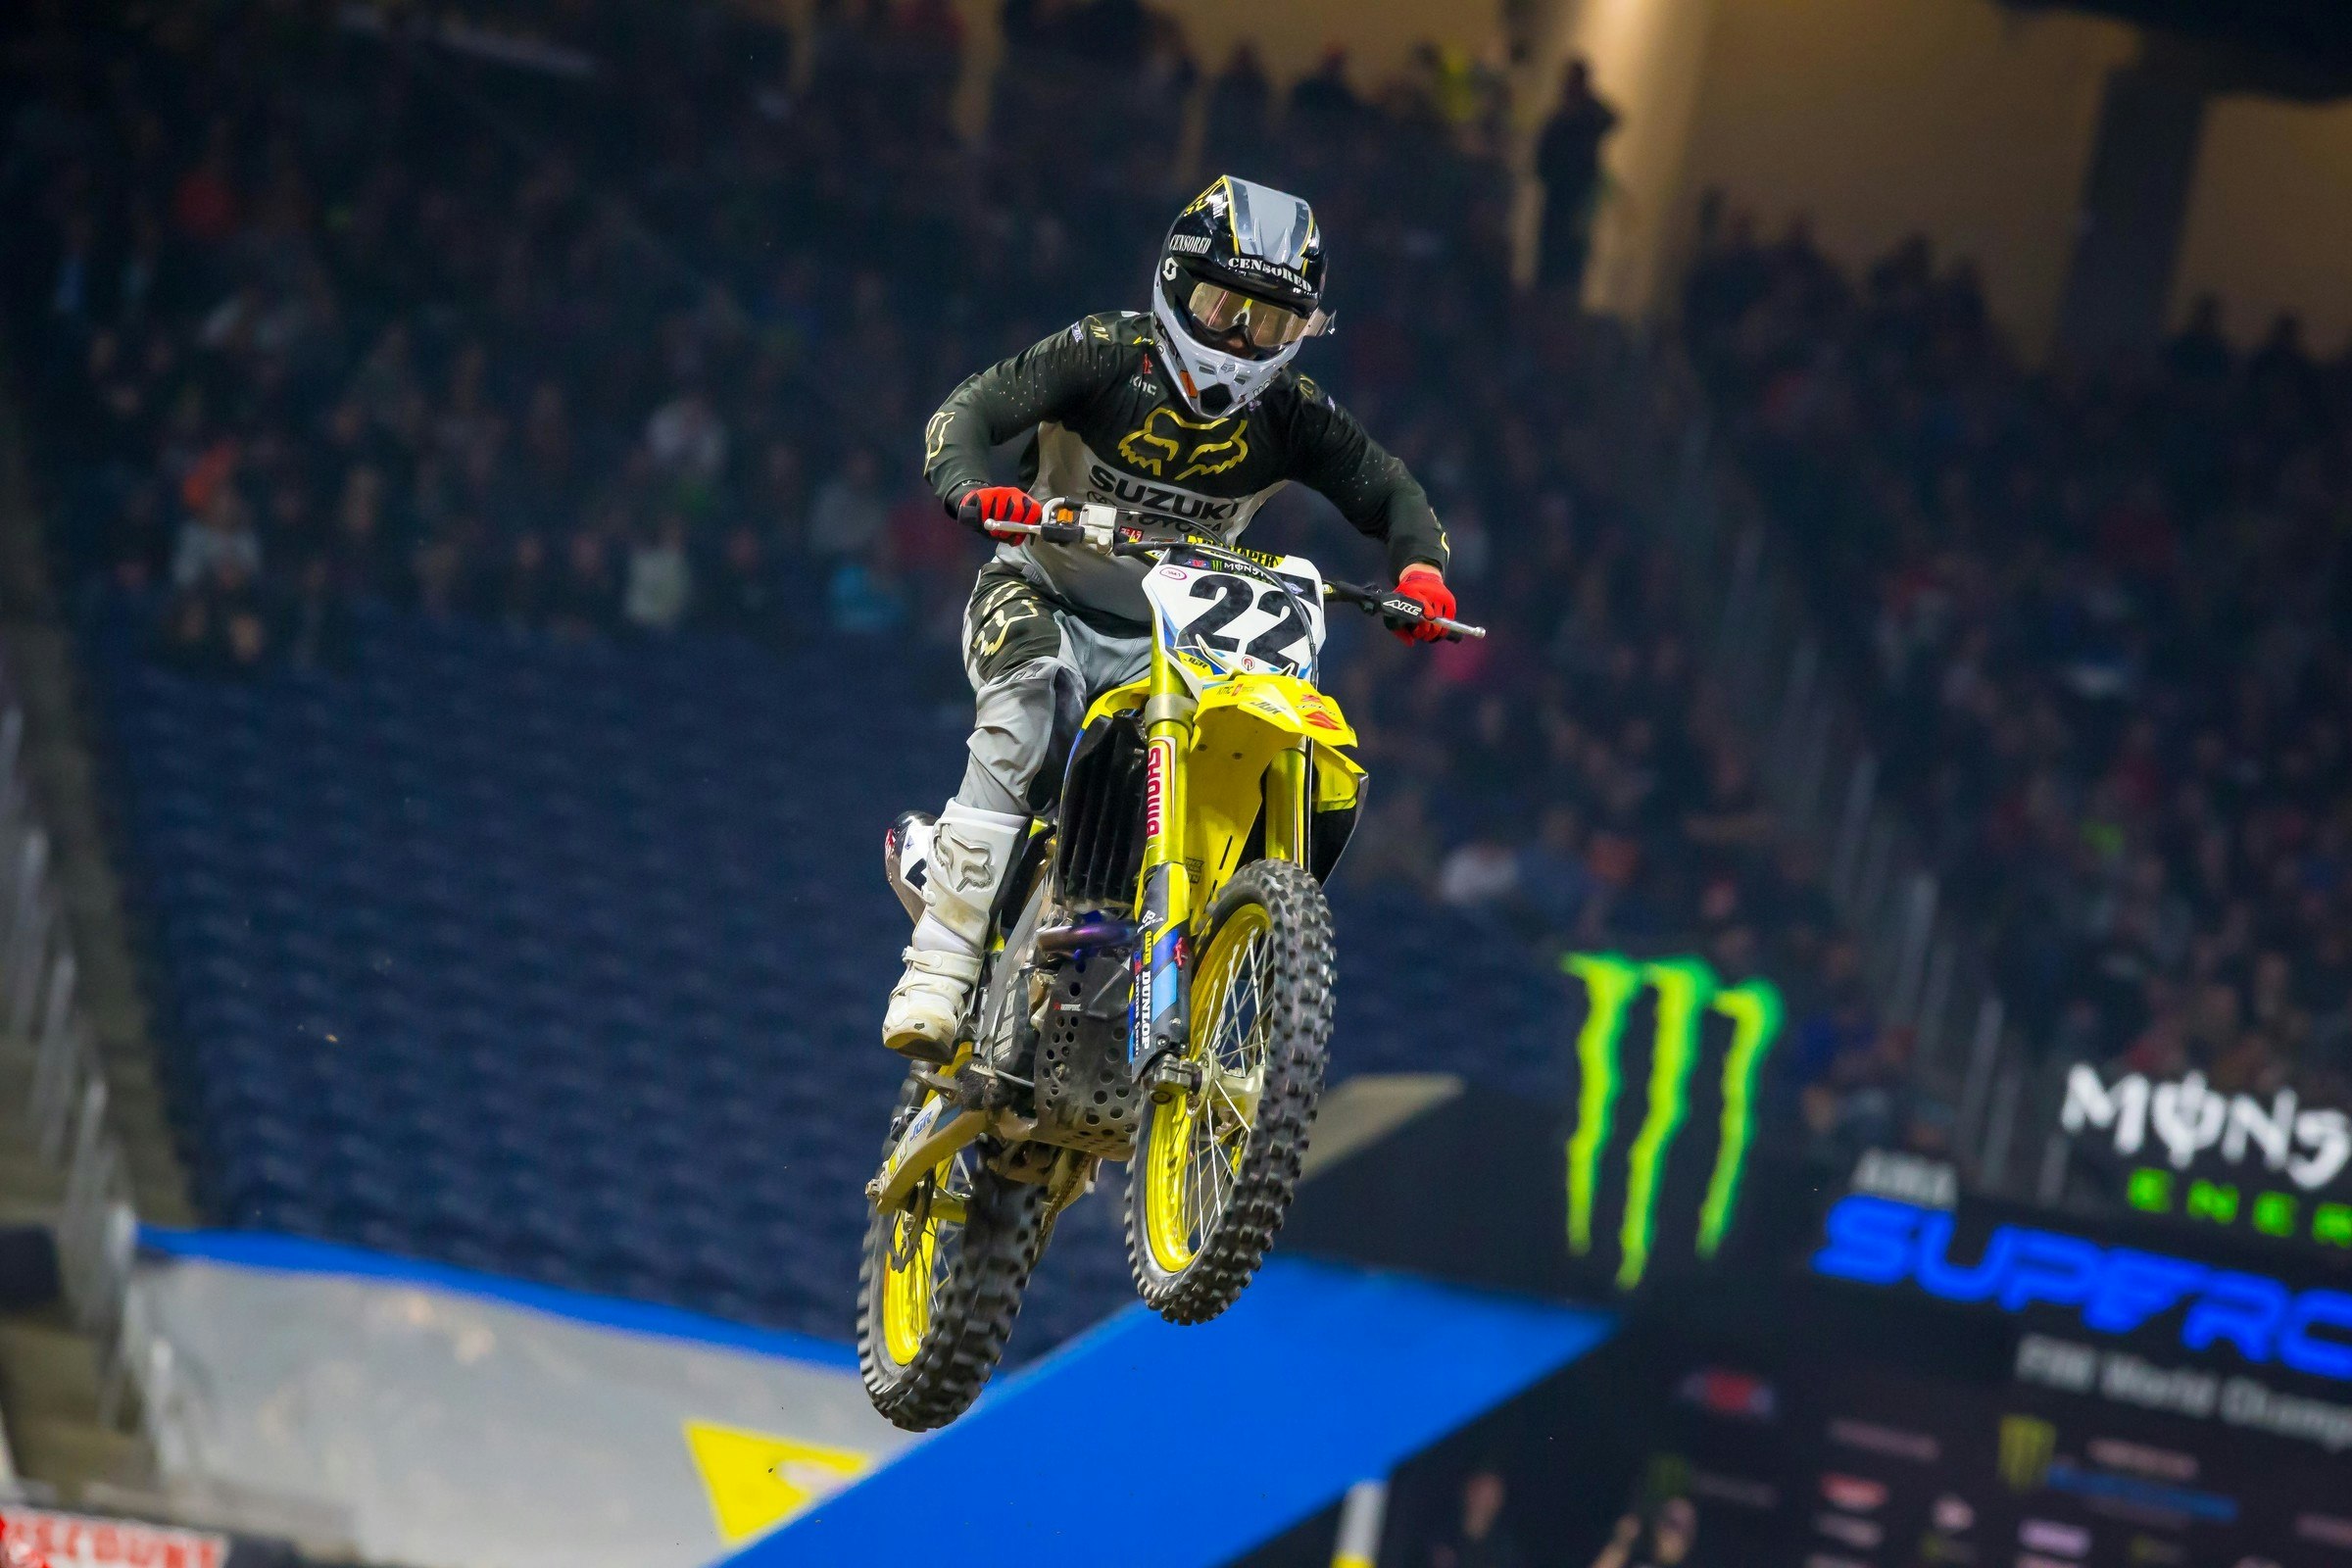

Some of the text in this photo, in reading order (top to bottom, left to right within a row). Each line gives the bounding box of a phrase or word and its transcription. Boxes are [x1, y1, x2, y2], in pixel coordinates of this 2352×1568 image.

[1170, 233, 1212, 255] CENSORED
[1228, 257, 1312, 292] CENSORED
[1089, 464, 1240, 520] SUZUKI
[1176, 573, 1311, 677] 22
[1383, 600, 1422, 616] ARC
[1142, 970, 1152, 1050] DUNLOP
